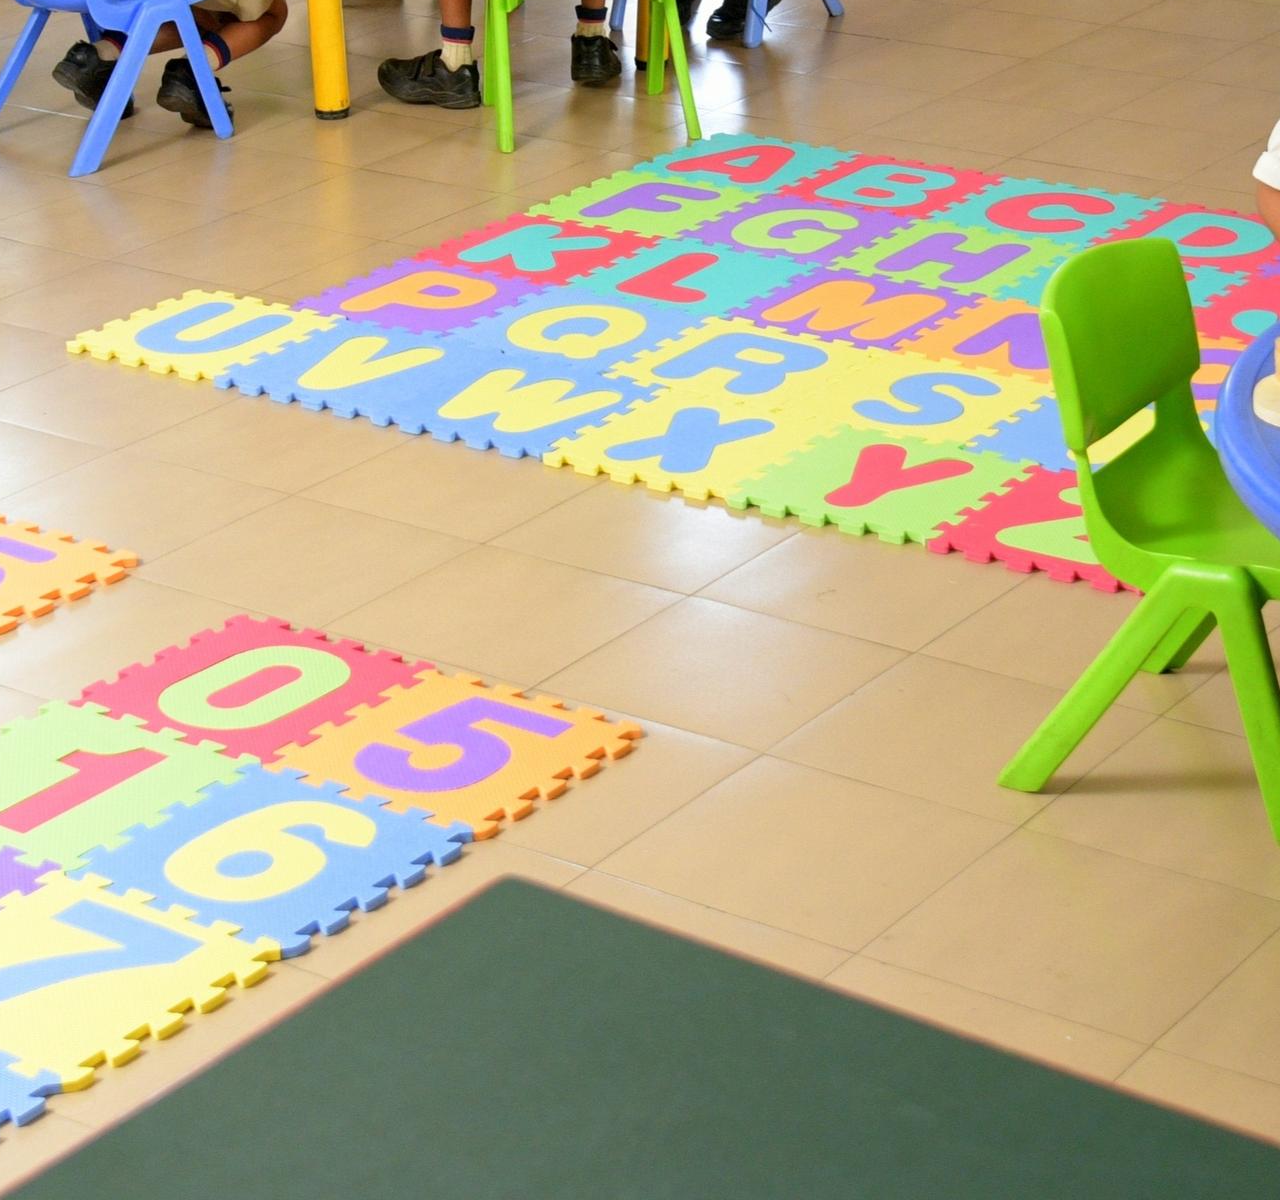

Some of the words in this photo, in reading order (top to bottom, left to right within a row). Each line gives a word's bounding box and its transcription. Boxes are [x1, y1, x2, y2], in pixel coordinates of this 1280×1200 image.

[579, 182, 720, 218] F
[730, 208, 860, 255] G
[875, 232, 1031, 282] H
[665, 145, 796, 184] A
[814, 164, 956, 207] B
[985, 192, 1115, 233] C
[1141, 212, 1274, 259] D
[457, 224, 612, 272] K
[617, 252, 719, 303] L
[761, 280, 947, 341] M
[135, 302, 293, 355] U
[297, 336, 445, 390] V
[437, 369, 623, 432] W
[604, 406, 775, 473] X
[823, 443, 974, 508] Y
[340, 271, 497, 312] P
[506, 304, 647, 359] Q
[652, 332, 828, 395] R
[852, 372, 1002, 425] S
[157, 644, 352, 731] 0
[352, 697, 578, 795] 5
[163, 800, 378, 903] 6
